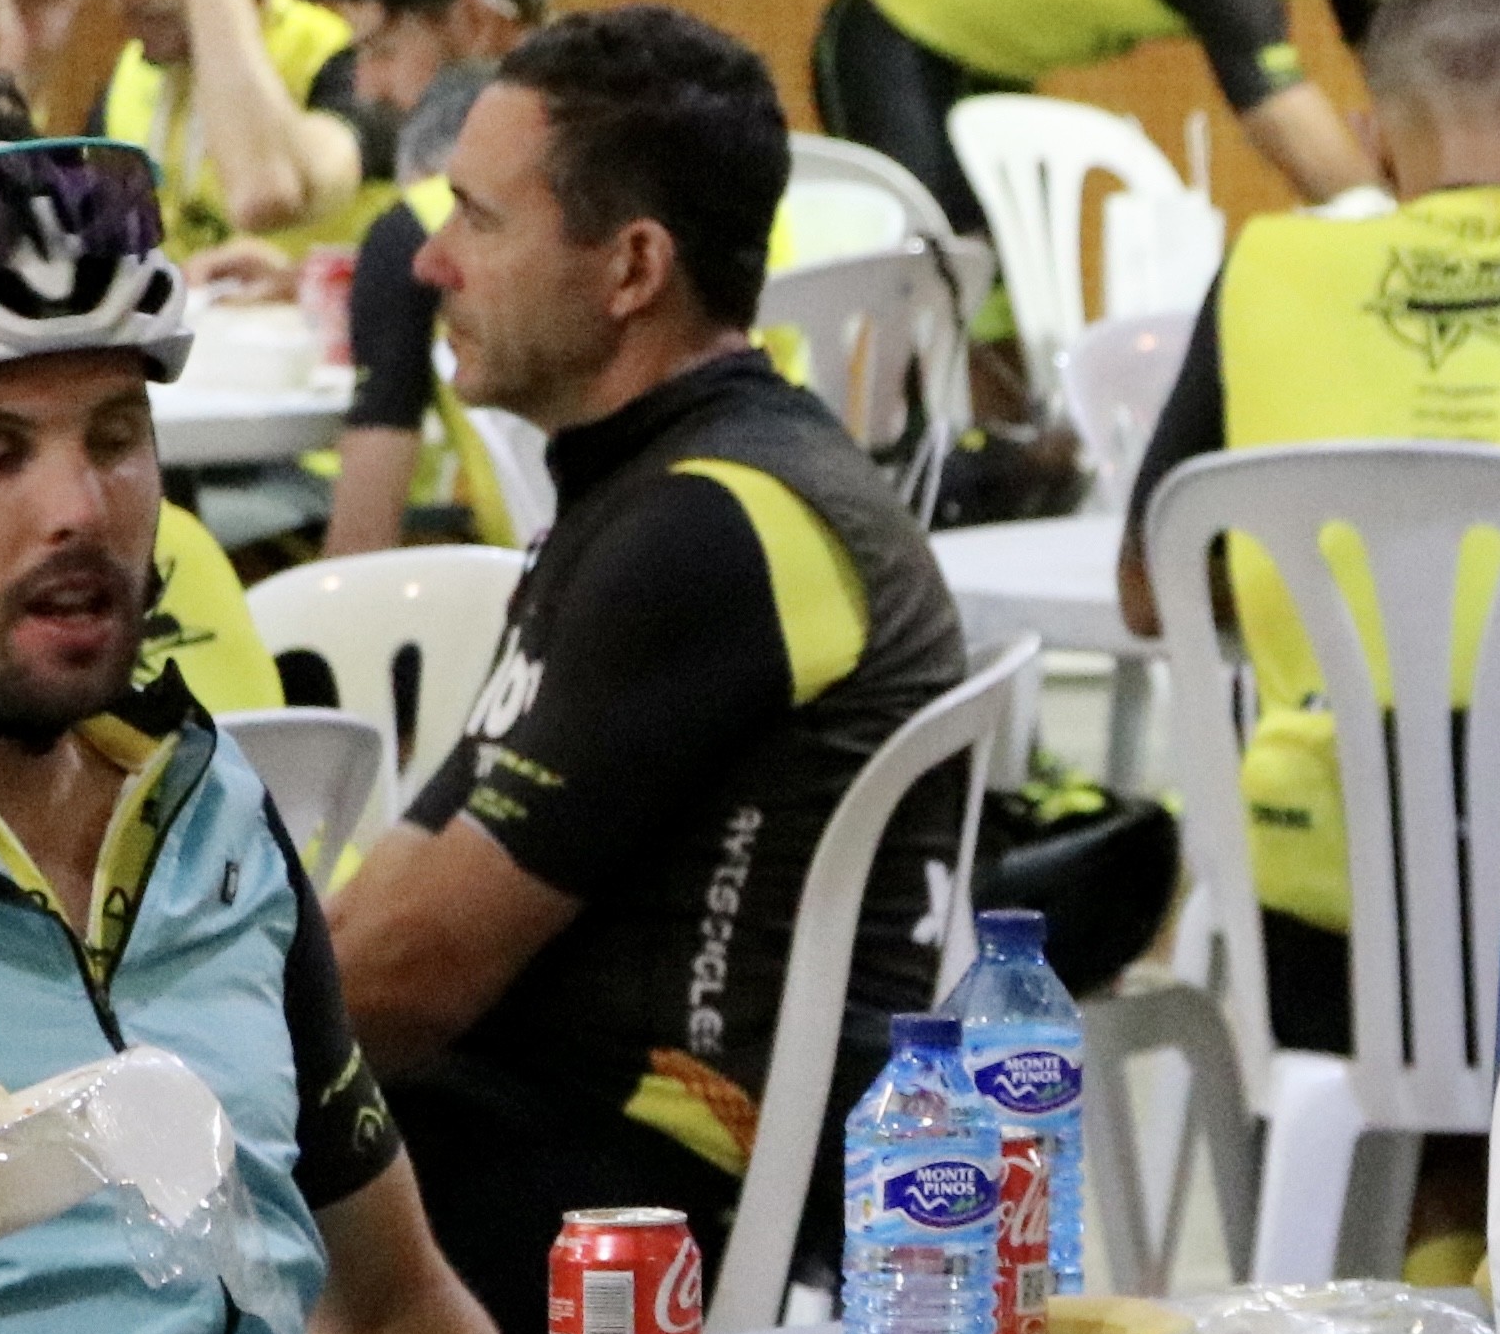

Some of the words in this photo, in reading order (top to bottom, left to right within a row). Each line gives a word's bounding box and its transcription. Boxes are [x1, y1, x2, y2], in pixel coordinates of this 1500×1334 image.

[1005, 1056, 1060, 1071] MONTE
[1011, 1070, 1062, 1084] PINOS
[915, 1167, 977, 1184] MONTE
[923, 1181, 977, 1196] PINOS
